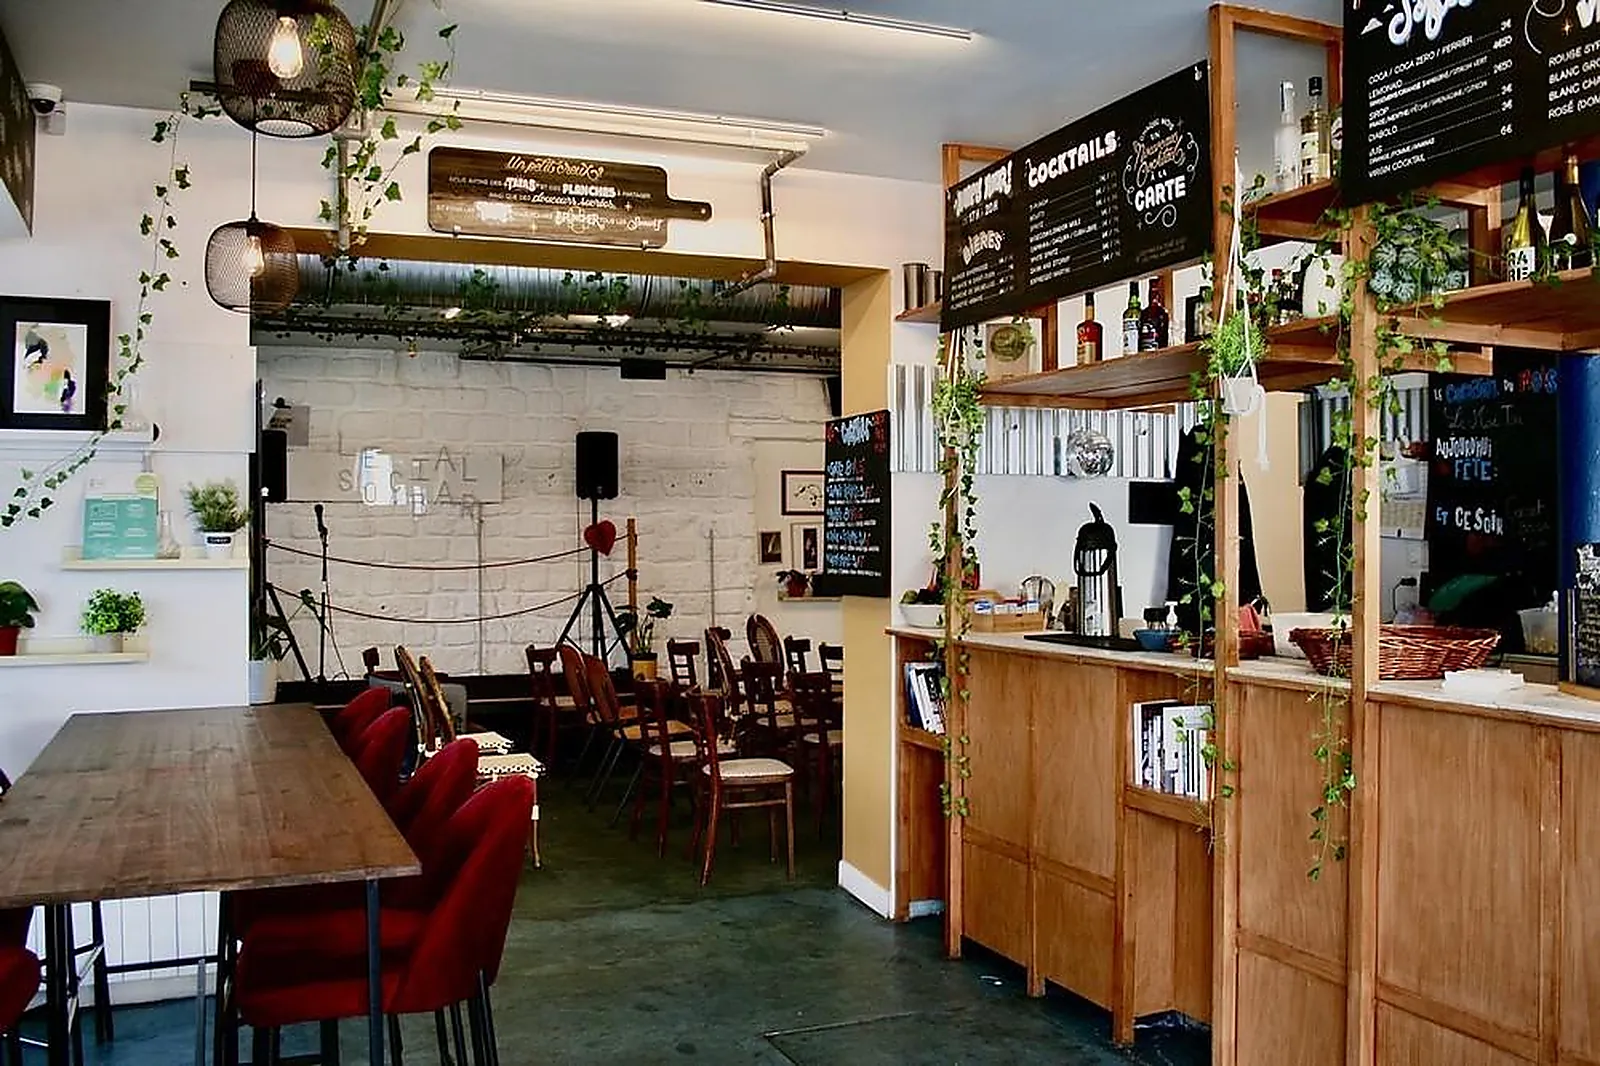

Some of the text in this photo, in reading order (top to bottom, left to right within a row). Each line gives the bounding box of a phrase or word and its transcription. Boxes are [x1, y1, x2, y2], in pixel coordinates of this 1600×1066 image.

[1368, 71, 1389, 85] COCA
[1394, 61, 1415, 75] COCA
[1416, 51, 1435, 67] ZERO
[1548, 46, 1582, 68] ROUGE
[1548, 65, 1580, 85] BLANC
[1548, 82, 1580, 101] BLANC
[1548, 100, 1574, 119] ROSÉ
[1028, 130, 1118, 188] COCKTAILS
[1134, 175, 1187, 212] CARTE
